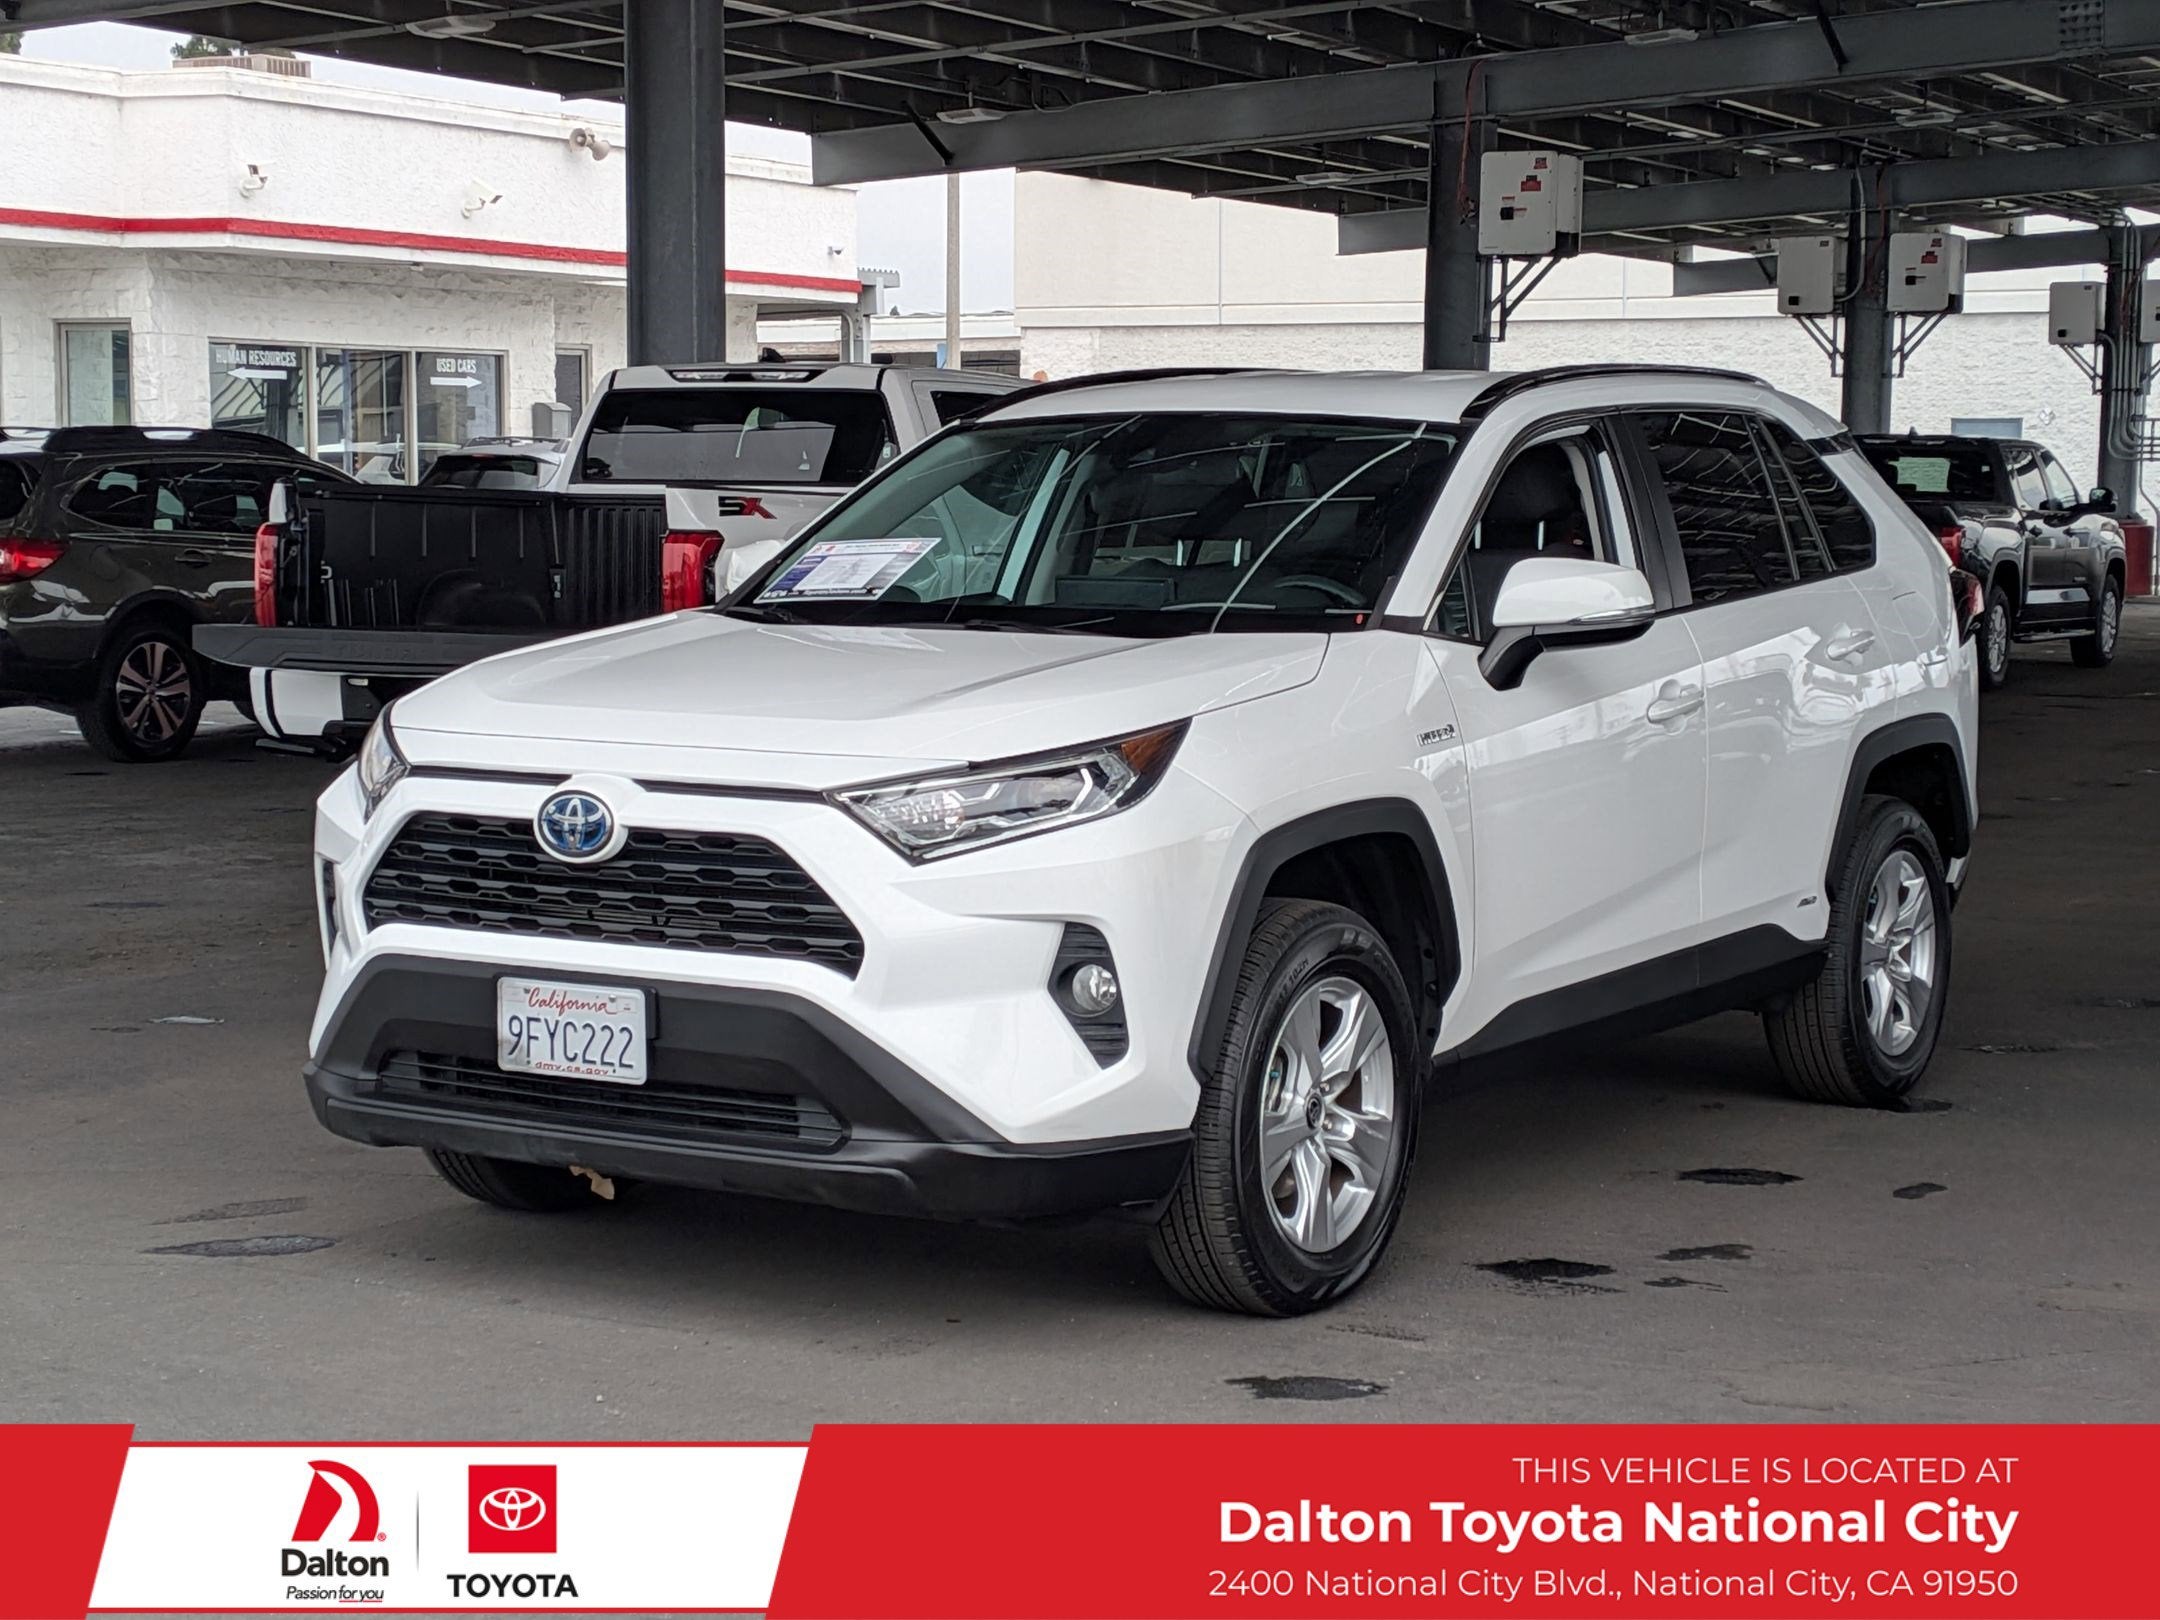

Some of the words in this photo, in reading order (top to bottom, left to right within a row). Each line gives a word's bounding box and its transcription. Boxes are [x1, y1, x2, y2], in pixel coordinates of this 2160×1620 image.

[248, 350, 297, 367] RESOURCES
[436, 358, 456, 373] USED
[457, 358, 477, 374] CARS
[528, 987, 617, 1017] California
[508, 1015, 634, 1069] 9FYC222
[535, 1061, 609, 1076] dmv.ca.gov
